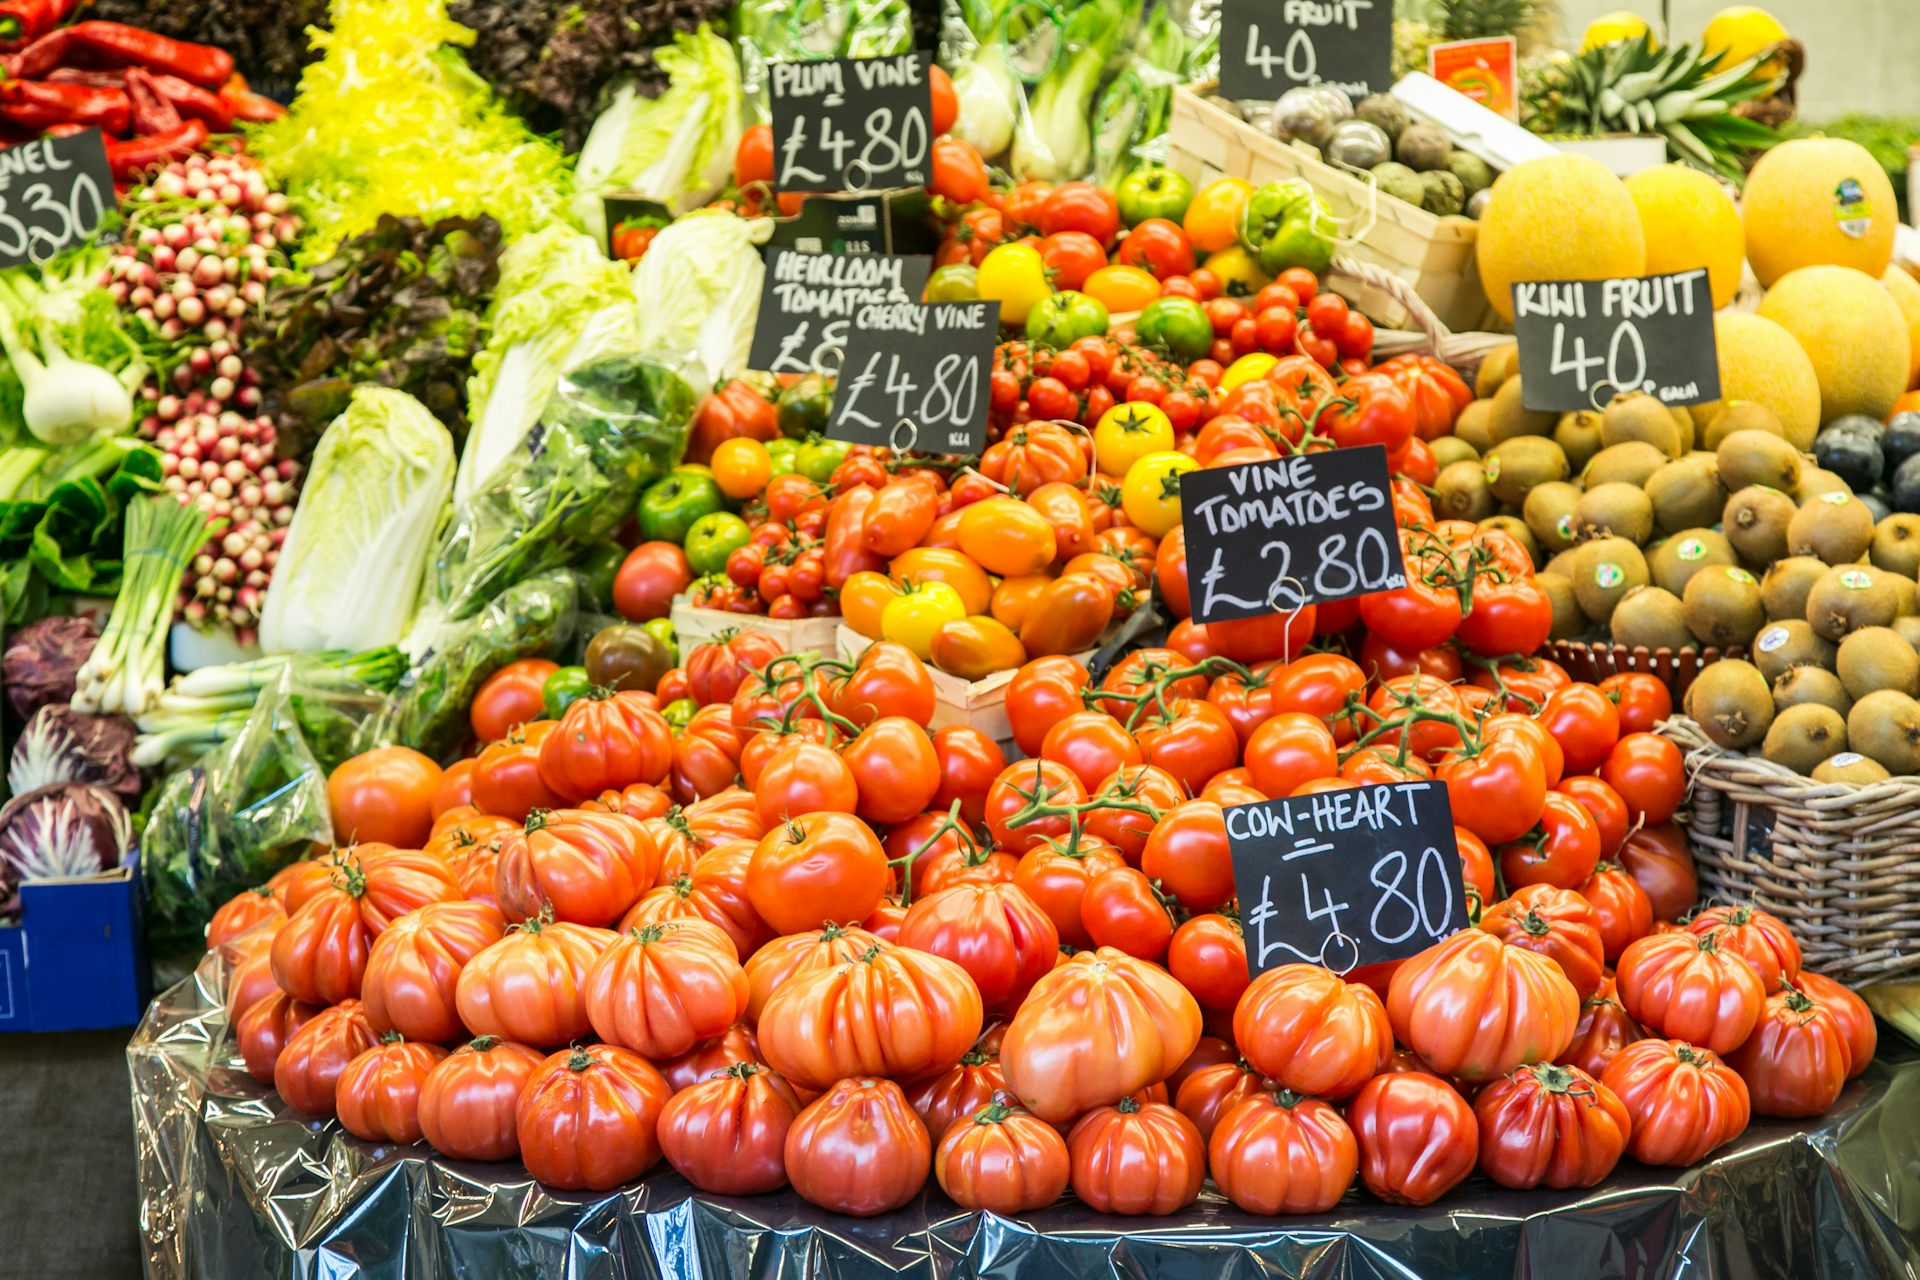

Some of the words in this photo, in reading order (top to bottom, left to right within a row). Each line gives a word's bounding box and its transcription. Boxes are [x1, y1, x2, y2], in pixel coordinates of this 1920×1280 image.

[1284, 0, 1374, 30] FRUIT
[773, 62, 846, 98] PLUM
[854, 54, 922, 90] VINE
[774, 251, 903, 289] HEIRLOOM
[1516, 281, 1587, 318] KIWI
[1602, 268, 1706, 318] FRUIT
[856, 302, 929, 337] CHERRY
[935, 303, 986, 330] VINE
[836, 351, 979, 428] £4.80
[1228, 456, 1316, 496] VINE
[1194, 481, 1386, 536] TOMATOES
[1201, 527, 1390, 617] £2.80
[1226, 783, 1431, 840] COW-HEART
[1248, 847, 1453, 968] £4.80
